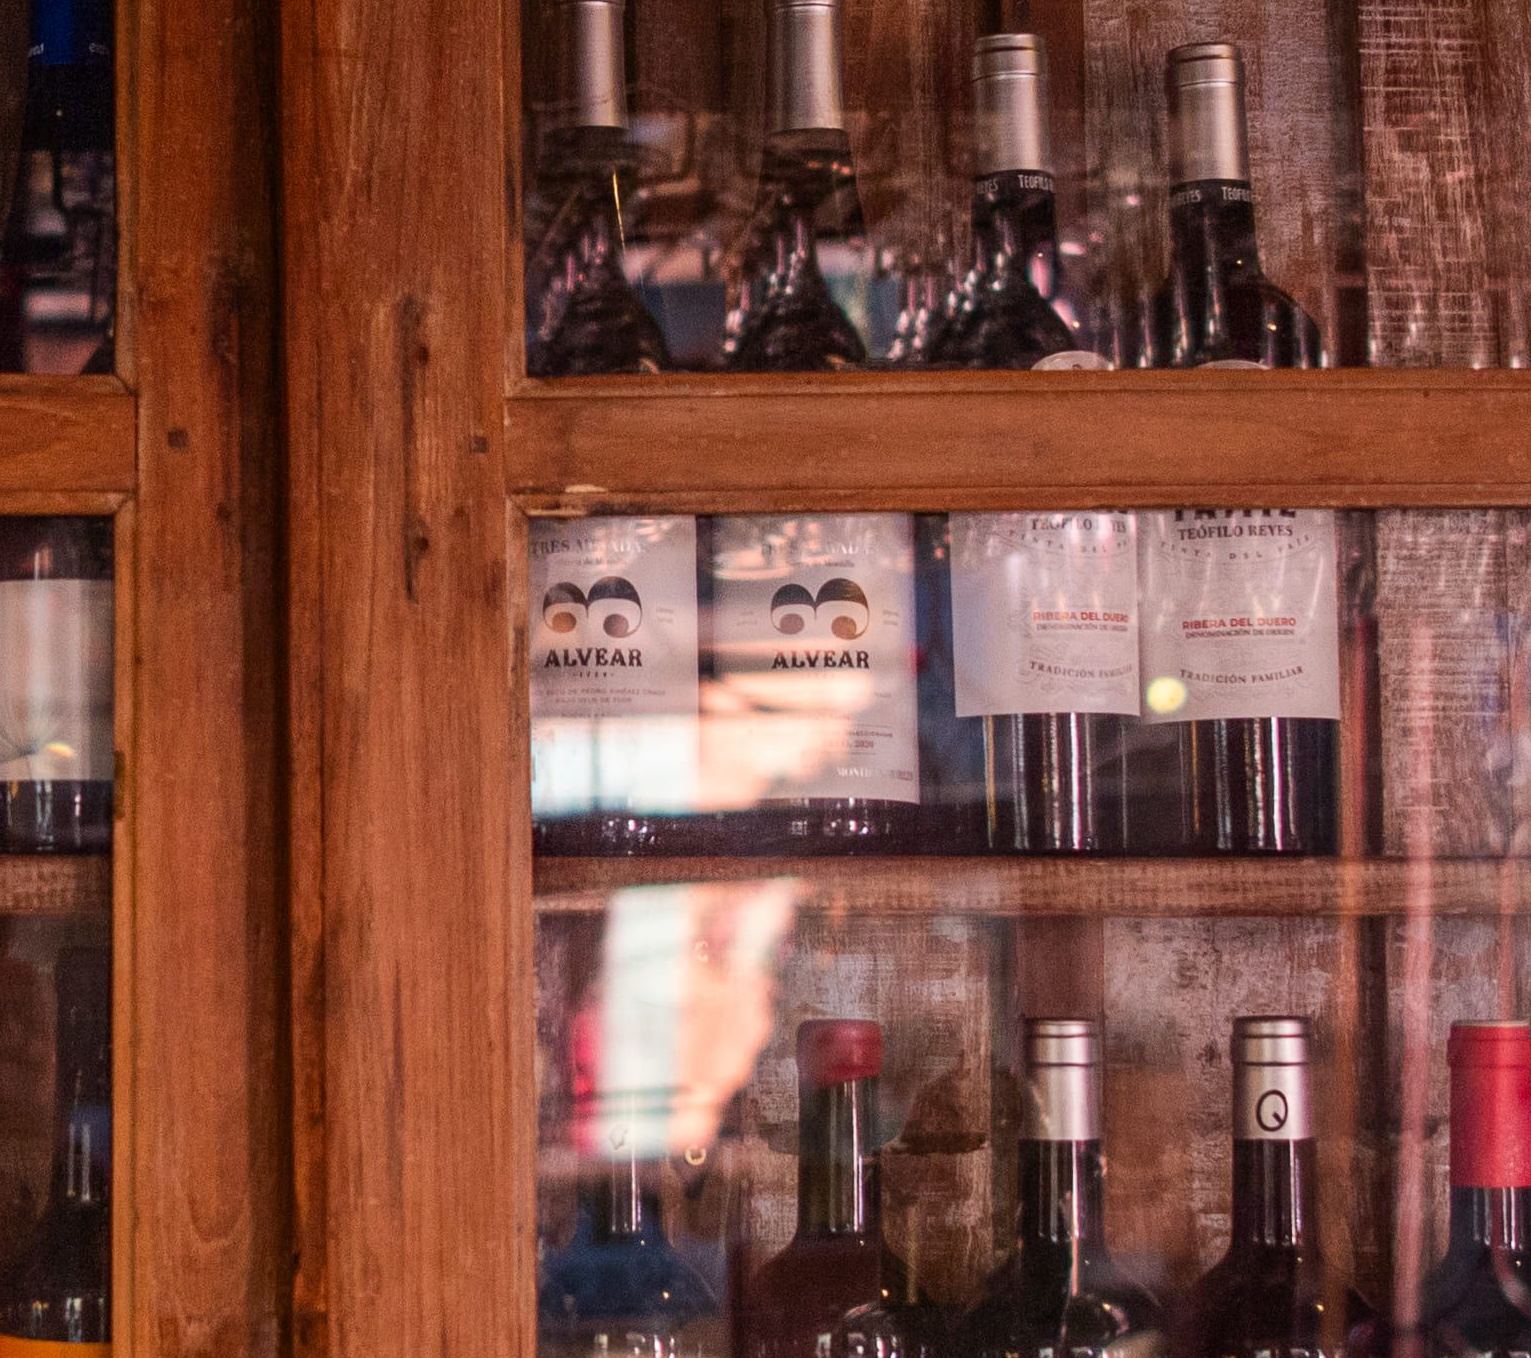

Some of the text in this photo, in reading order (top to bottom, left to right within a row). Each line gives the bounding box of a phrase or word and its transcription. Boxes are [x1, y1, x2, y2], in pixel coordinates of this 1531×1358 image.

[1178, 524, 1294, 541] TEÓFILO REYES
[1182, 617, 1297, 631] RIBERA DEL DUERO
[543, 646, 643, 668] ALVEAR
[771, 649, 871, 670] ALVEAR
[1256, 1089, 1289, 1132] Q
